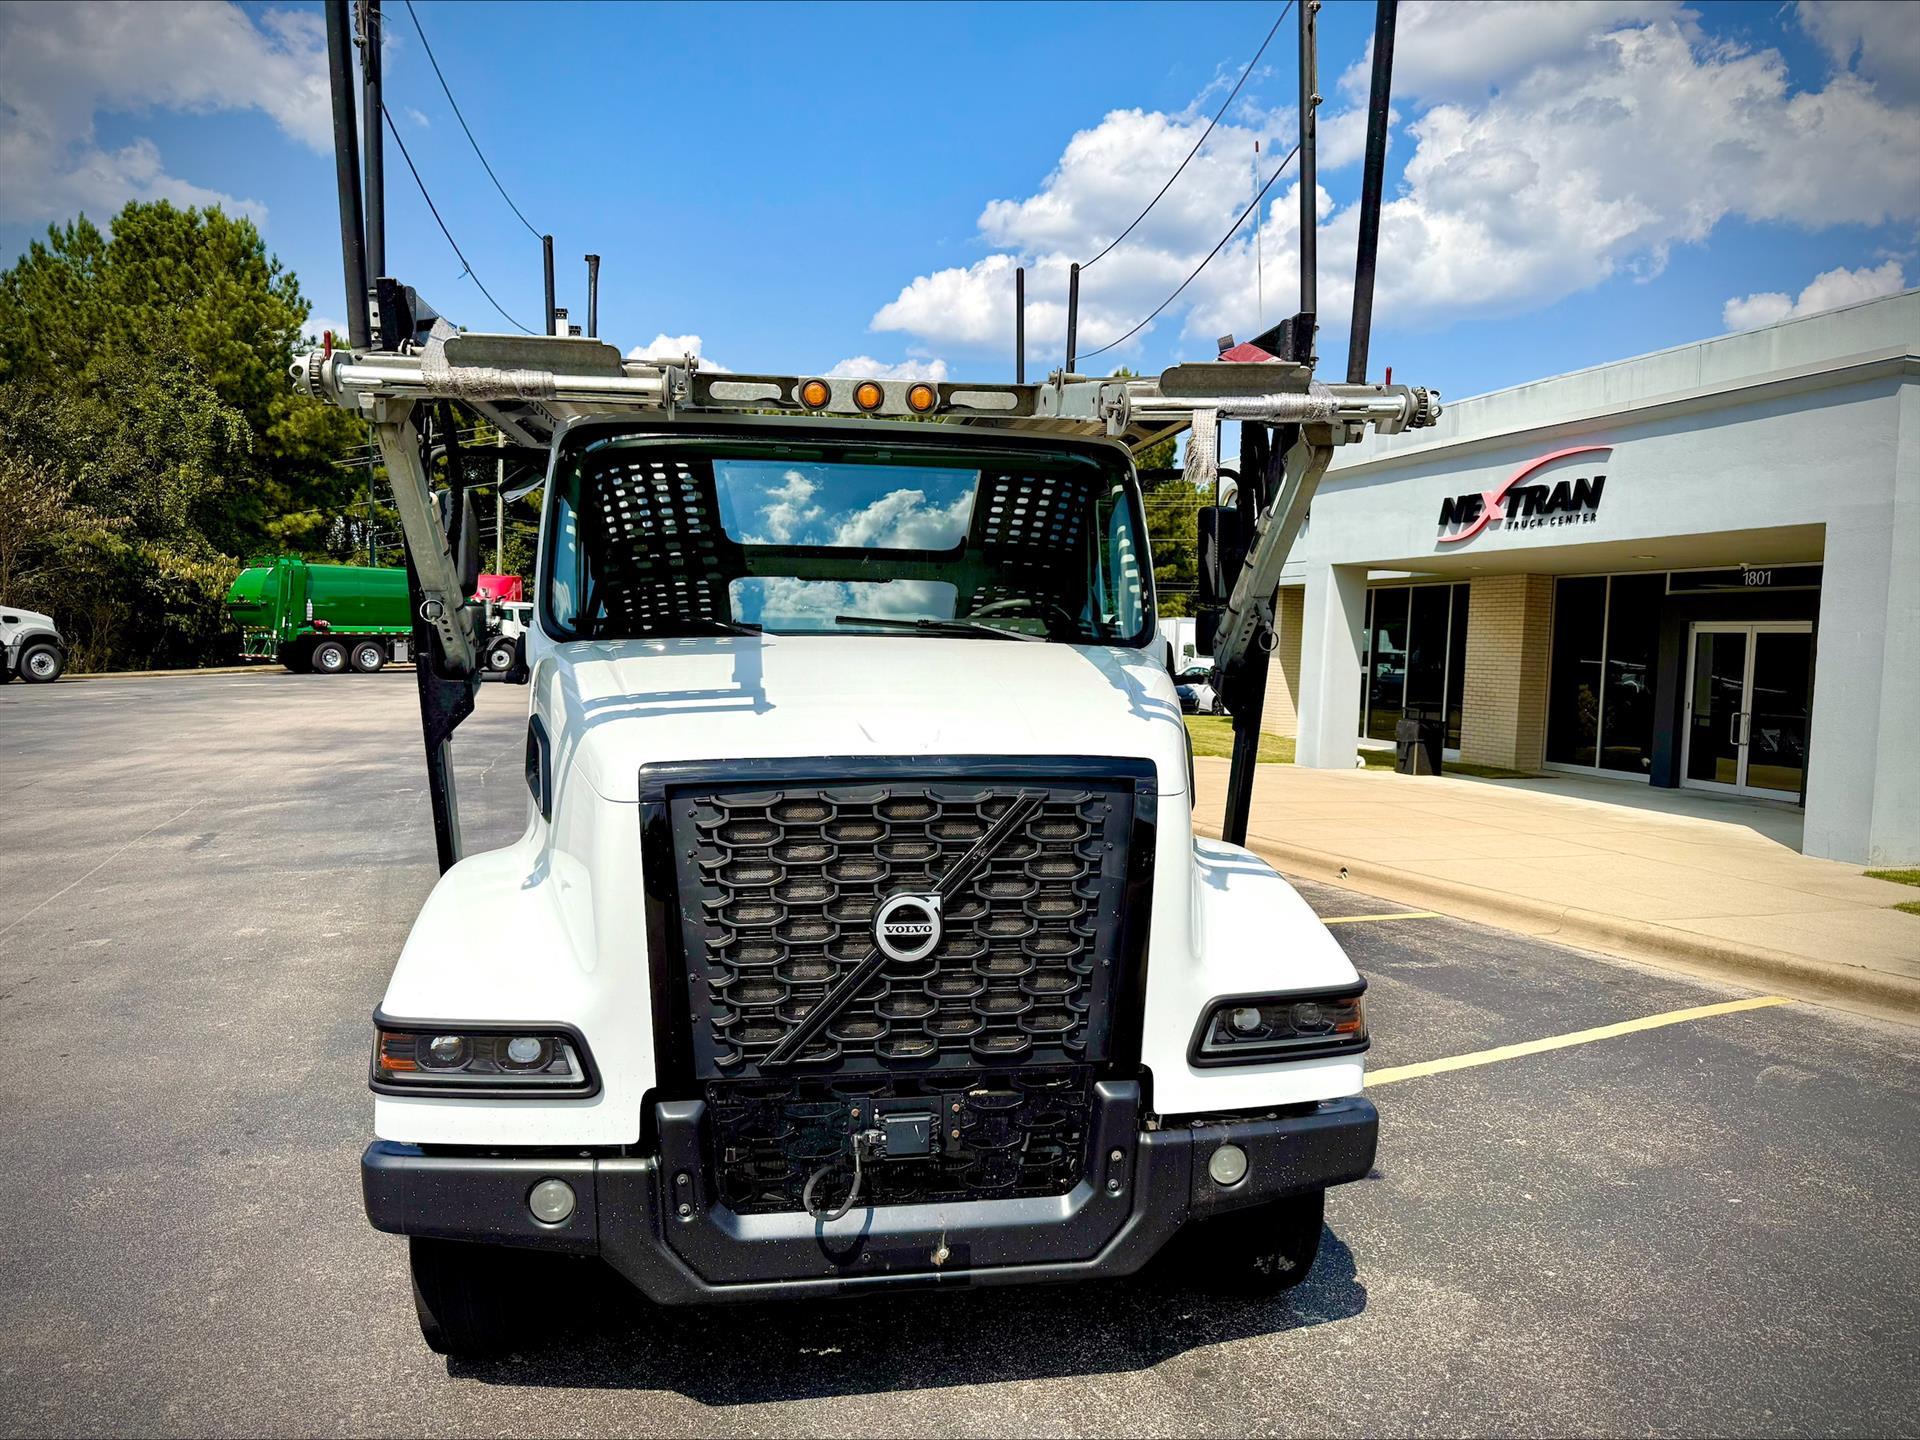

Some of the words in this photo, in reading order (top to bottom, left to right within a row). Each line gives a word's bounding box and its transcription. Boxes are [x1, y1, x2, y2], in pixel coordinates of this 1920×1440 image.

[1438, 474, 1607, 528] NEXTRAN
[1507, 517, 1544, 530] TRUCK
[1550, 512, 1597, 526] CENTER
[1742, 570, 1772, 586] 1801
[884, 925, 933, 934] VOLVO
